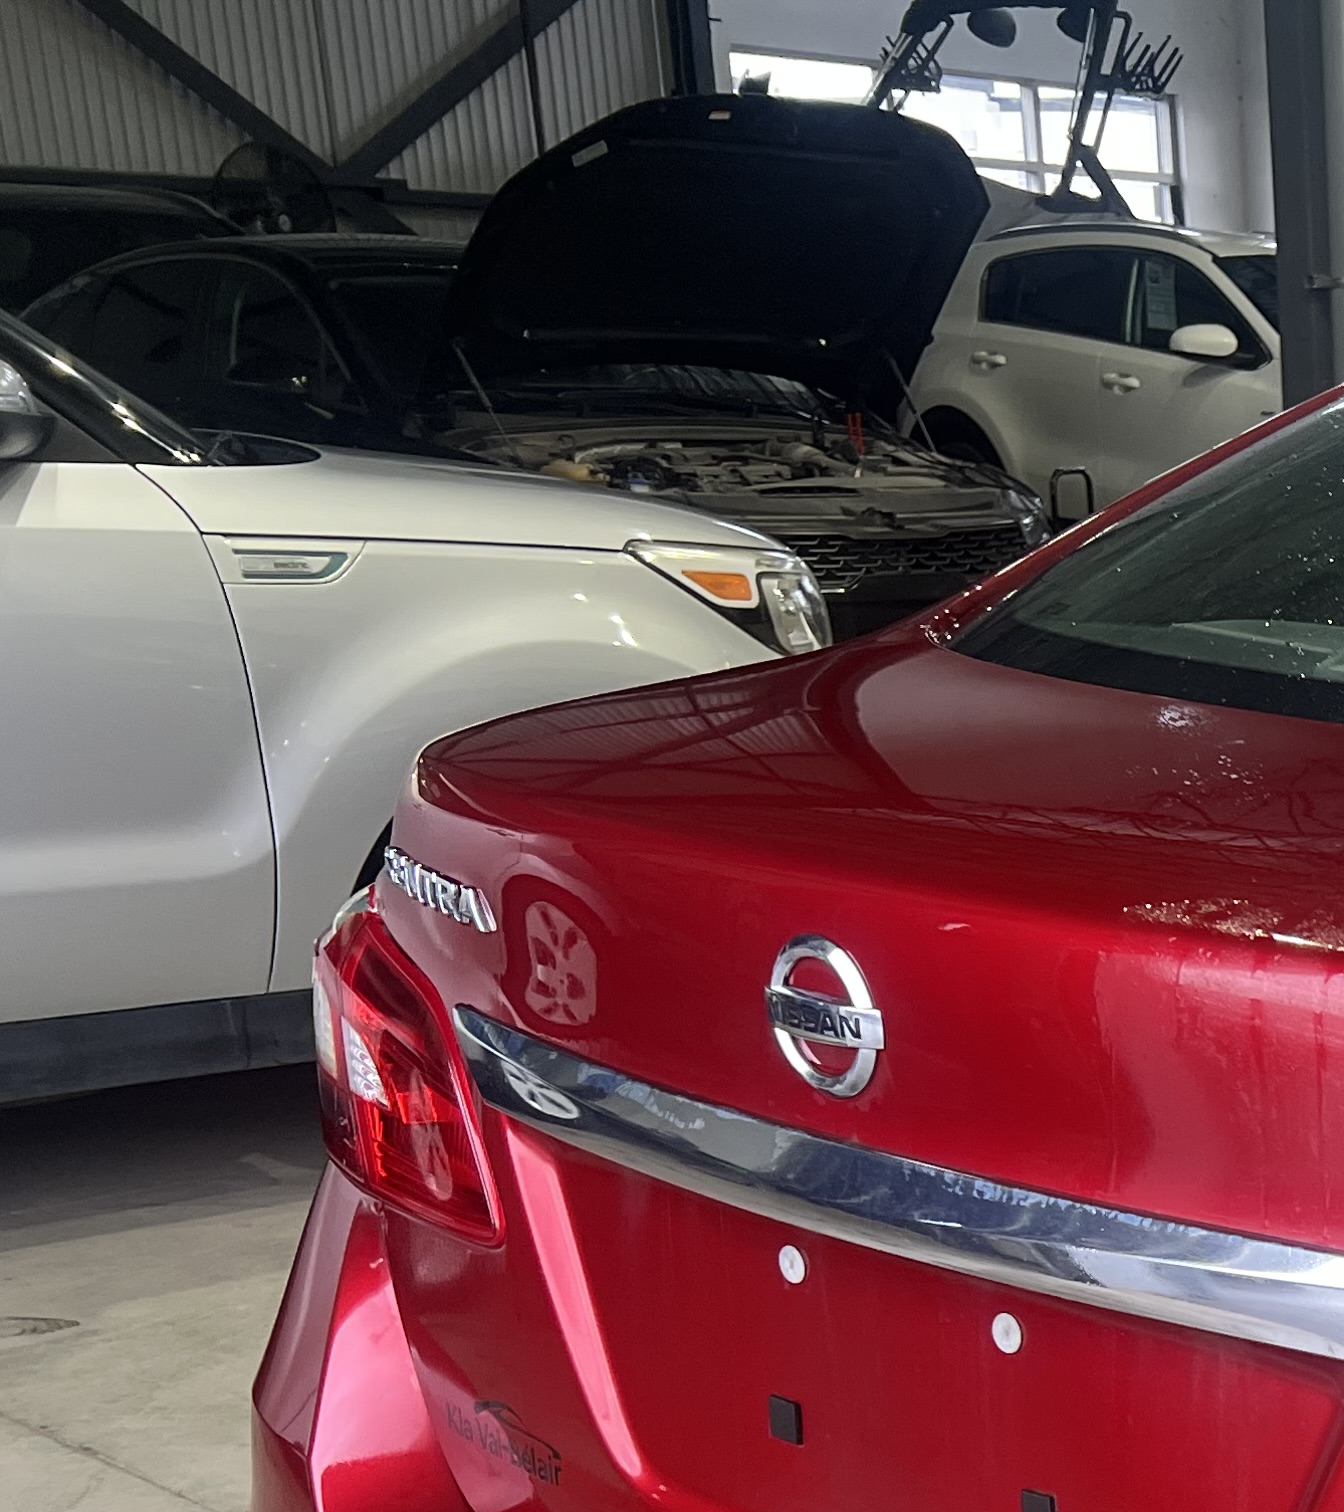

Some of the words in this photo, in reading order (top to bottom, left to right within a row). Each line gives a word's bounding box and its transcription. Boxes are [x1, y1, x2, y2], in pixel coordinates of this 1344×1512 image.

[766, 990, 862, 1040] NISSAN
[446, 1401, 473, 1442] Kia
[475, 1418, 562, 1486] Val-Bélair
